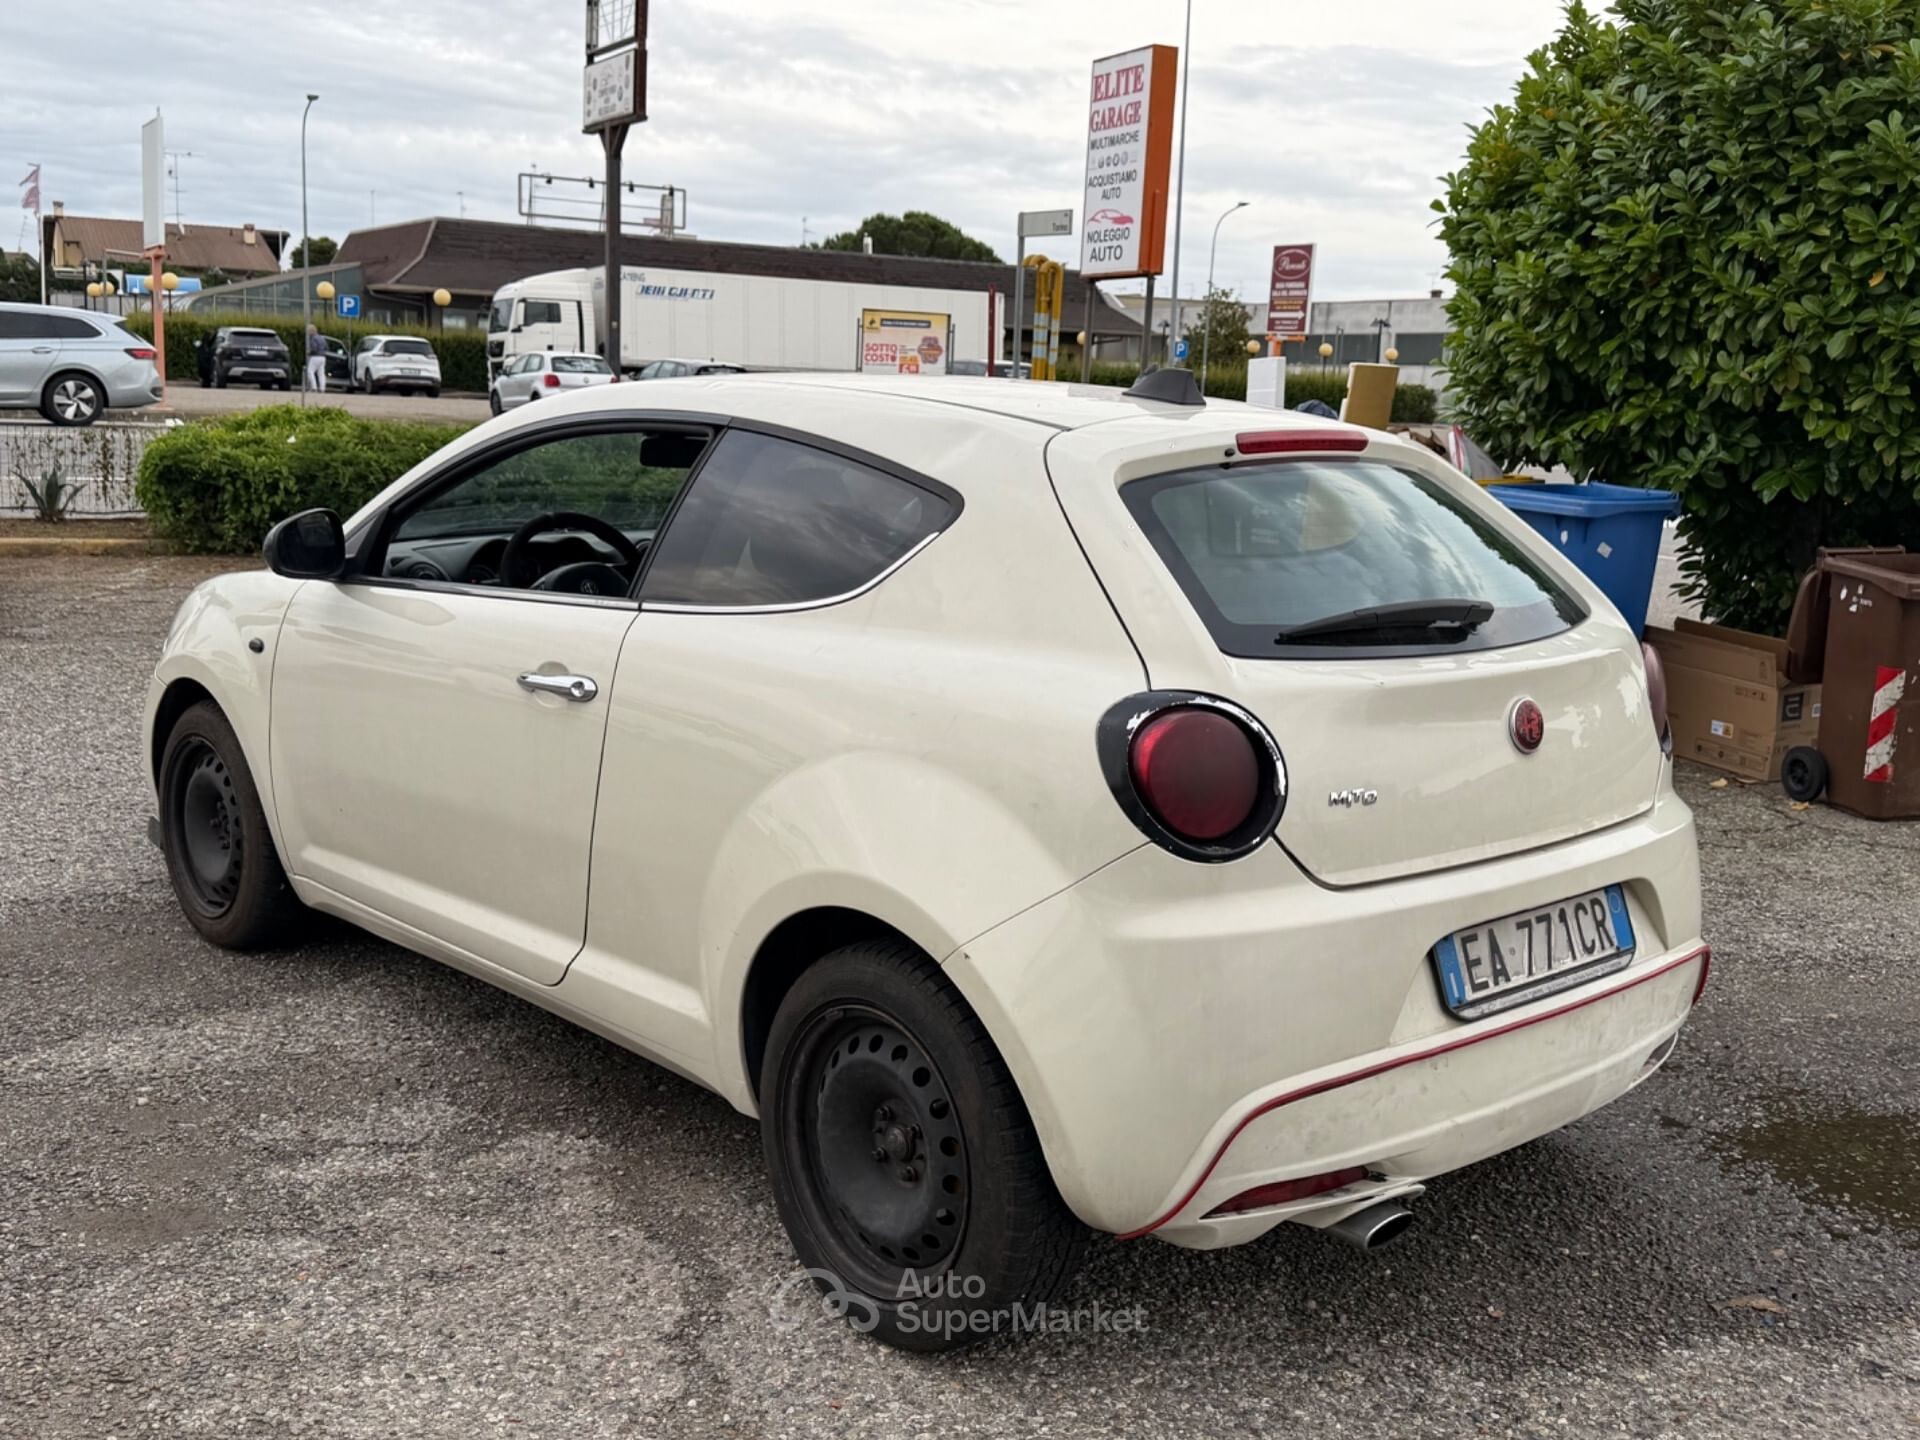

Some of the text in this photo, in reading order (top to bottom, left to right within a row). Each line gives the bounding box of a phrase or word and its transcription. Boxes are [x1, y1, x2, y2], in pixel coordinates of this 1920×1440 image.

[1093, 64, 1144, 102] ELITE
[1091, 101, 1141, 132] GARAGE
[1090, 130, 1139, 150] MULTIMARCHE
[1088, 169, 1137, 188] ACQUISTIAMO
[1101, 187, 1121, 200] AUTO
[1087, 227, 1130, 243] NOLEGGIO
[1089, 245, 1123, 262] AUTO
[342, 297, 355, 313] P
[865, 343, 898, 353] SOTTO
[1176, 343, 1185, 355] P
[1460, 928, 1511, 993] EA
